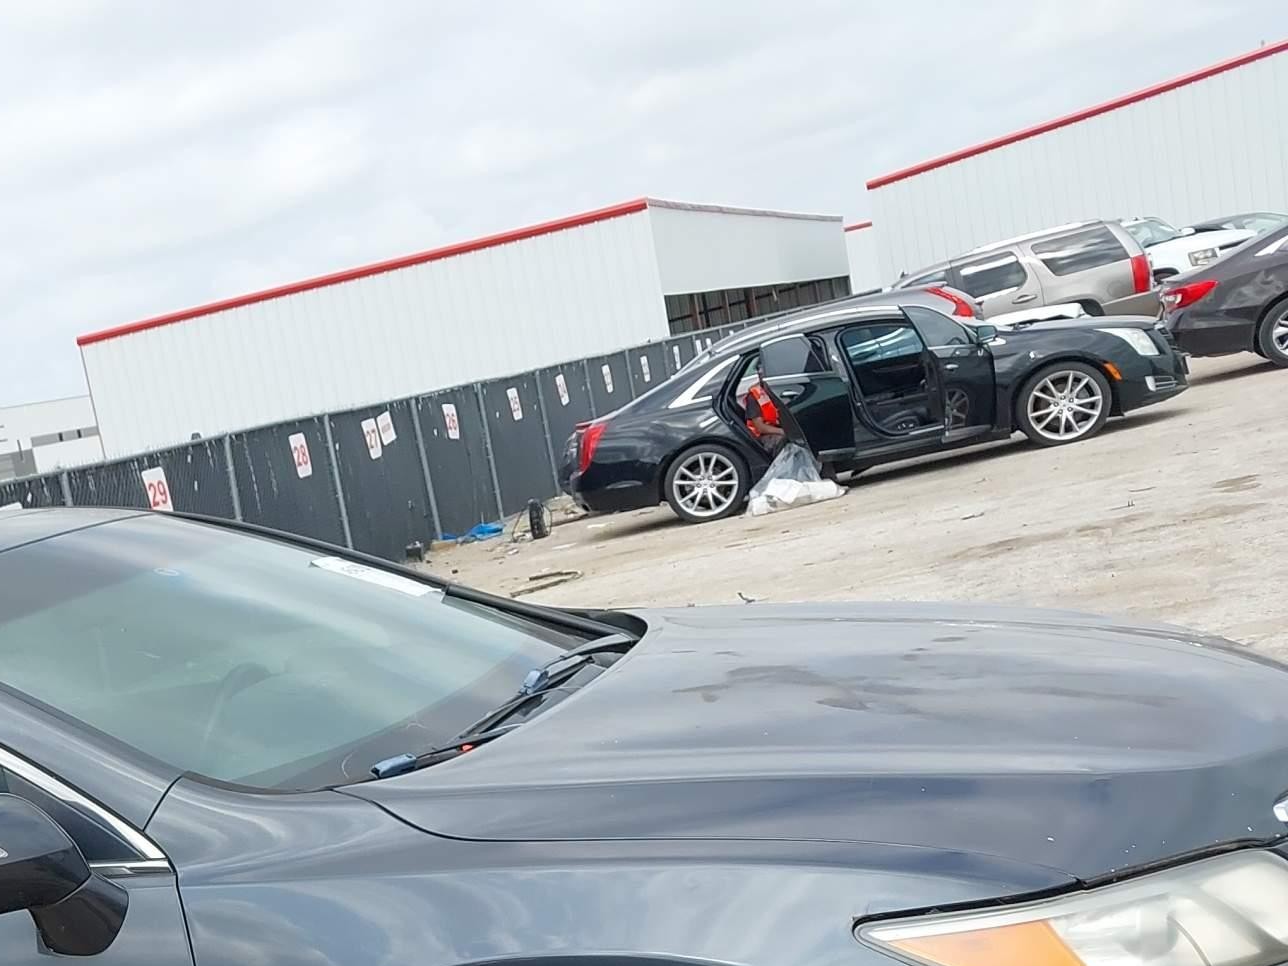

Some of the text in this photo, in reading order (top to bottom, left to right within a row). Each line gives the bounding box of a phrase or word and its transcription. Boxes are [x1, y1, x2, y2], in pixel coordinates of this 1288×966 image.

[446, 412, 457, 430] 26
[366, 428, 378, 450] 27
[294, 445, 308, 467] 28
[148, 480, 168, 507] 29
